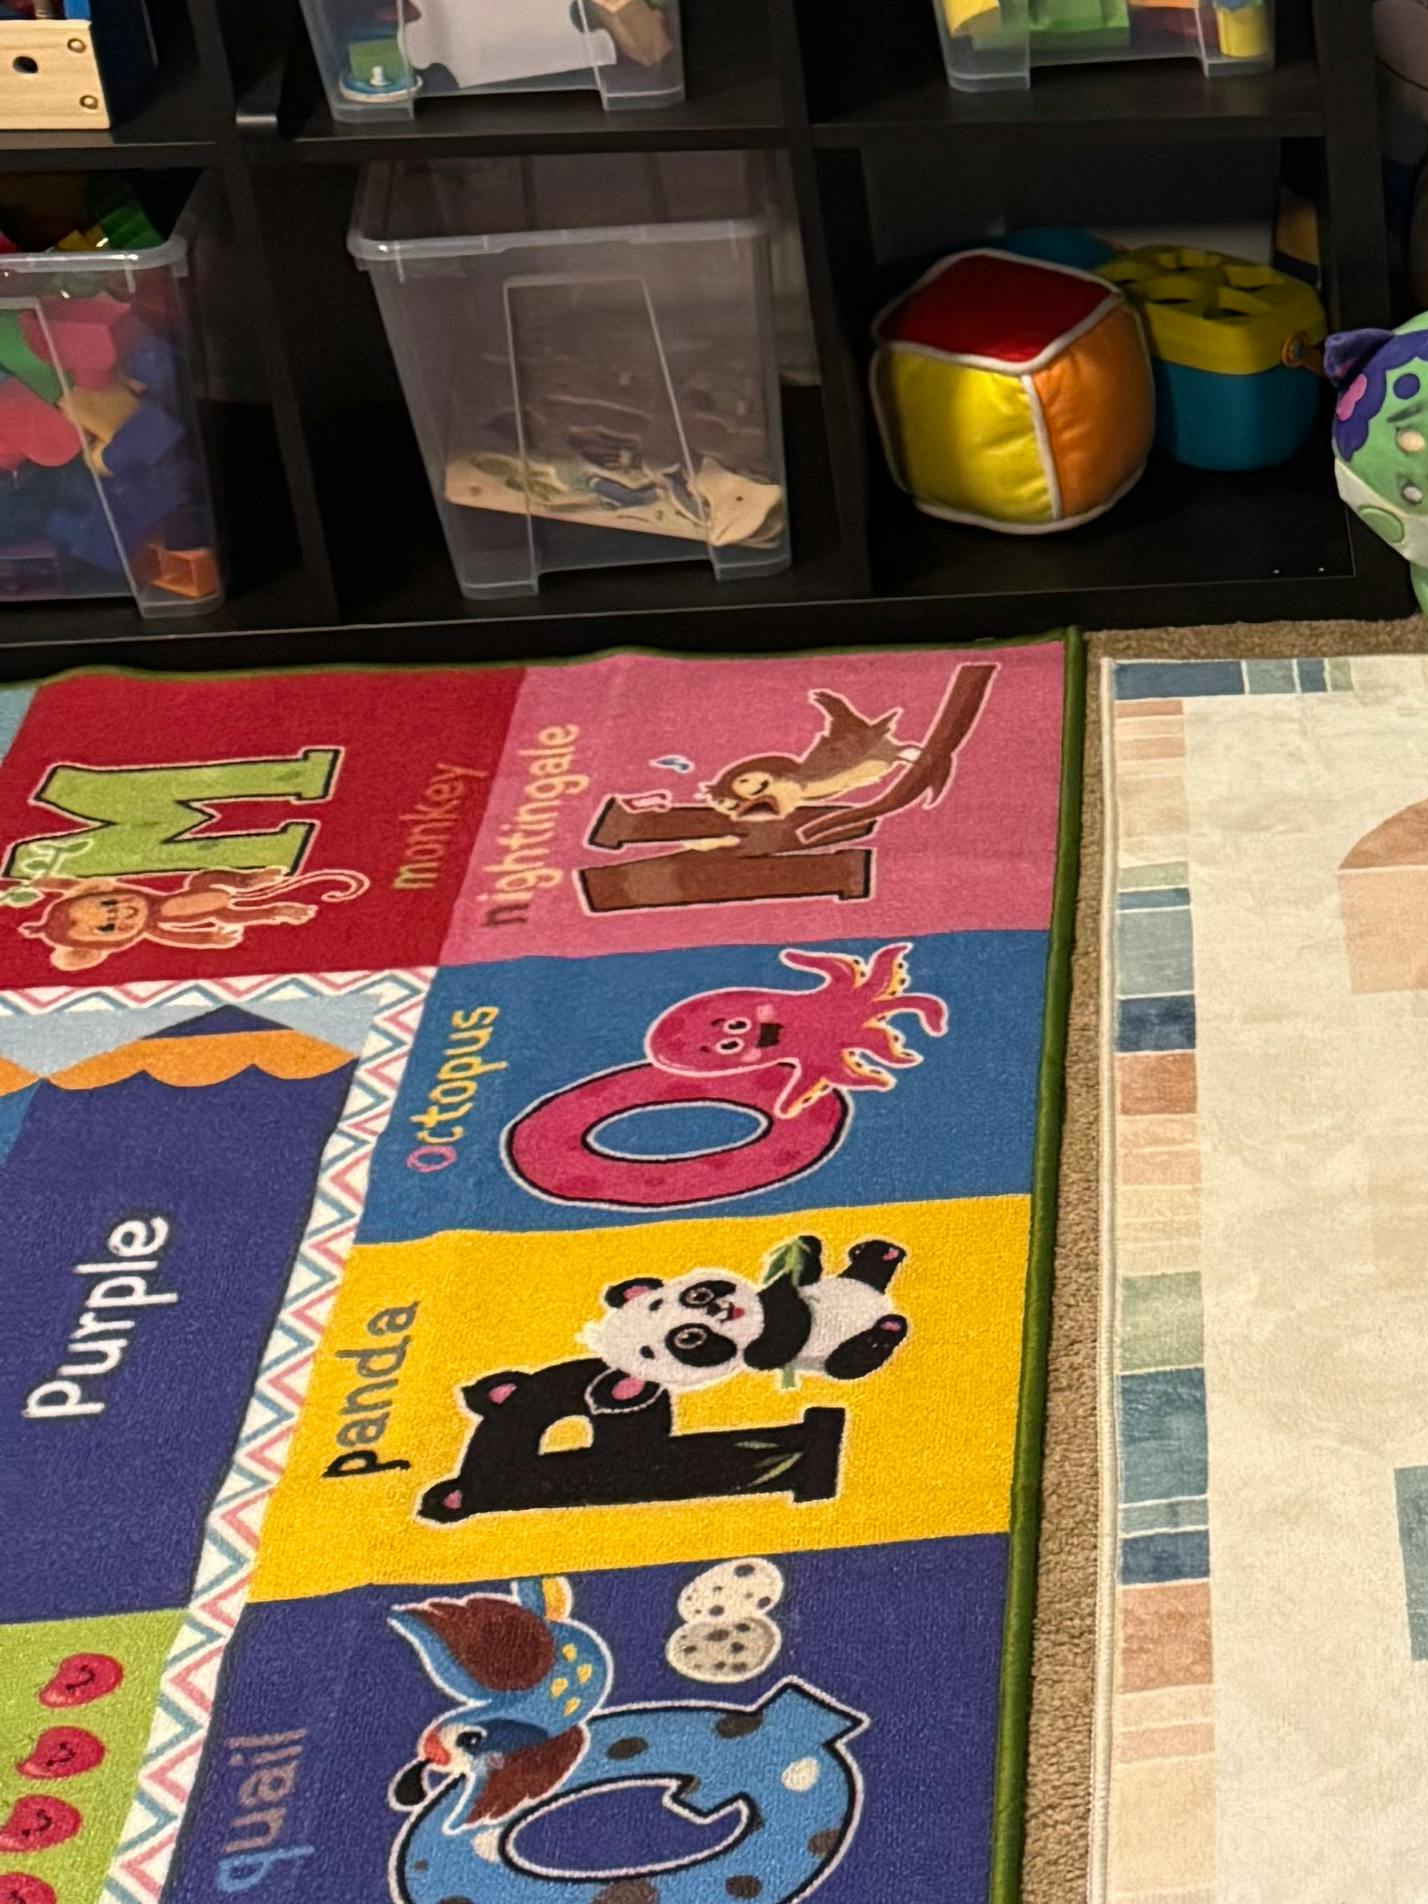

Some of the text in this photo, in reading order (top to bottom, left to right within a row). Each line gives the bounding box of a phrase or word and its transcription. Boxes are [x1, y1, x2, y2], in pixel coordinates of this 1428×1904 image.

[1, 746, 346, 881] M
[392, 760, 491, 893] monkey
[477, 721, 585, 931] nightingale
[405, 1004, 500, 1174] octopus
[500, 1058, 851, 1208] O
[22, 1213, 179, 1422] Purple
[322, 1299, 422, 1481] panda
[216, 1728, 316, 1893] quail
